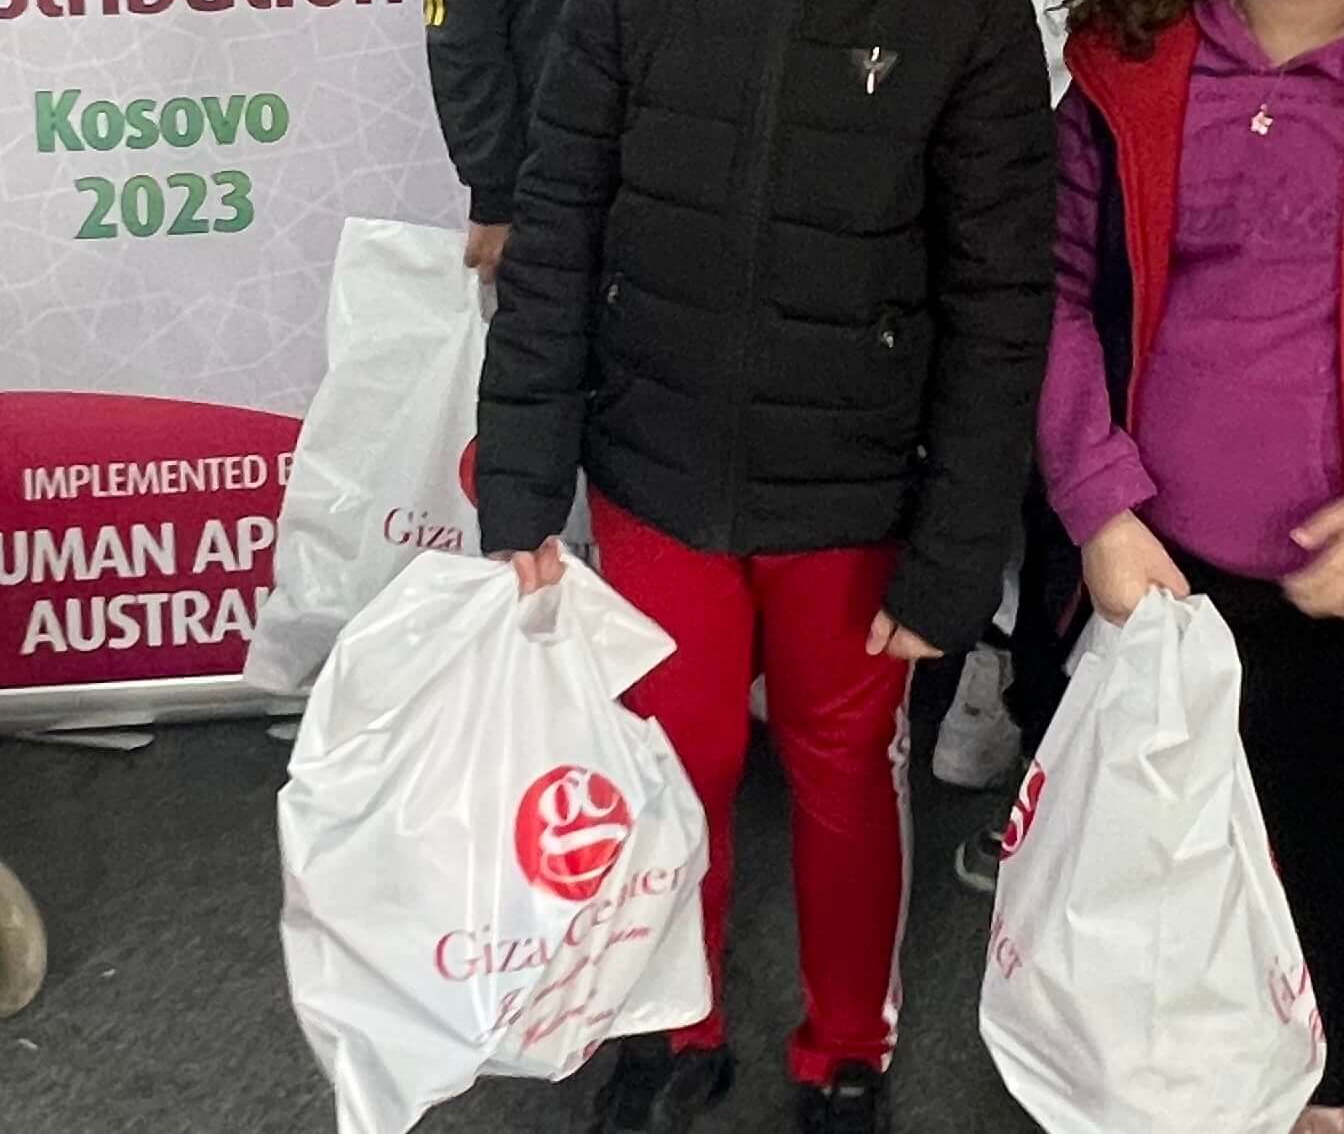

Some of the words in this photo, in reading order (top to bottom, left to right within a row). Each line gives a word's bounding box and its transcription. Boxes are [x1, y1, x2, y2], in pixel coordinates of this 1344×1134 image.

[34, 89, 289, 153] Kosovo
[73, 171, 255, 240] 2023
[22, 454, 268, 500] IMPLEMENTED
[383, 507, 464, 550] Giza
[21, 586, 268, 655] AUSTRA
[433, 926, 551, 982] Giza
